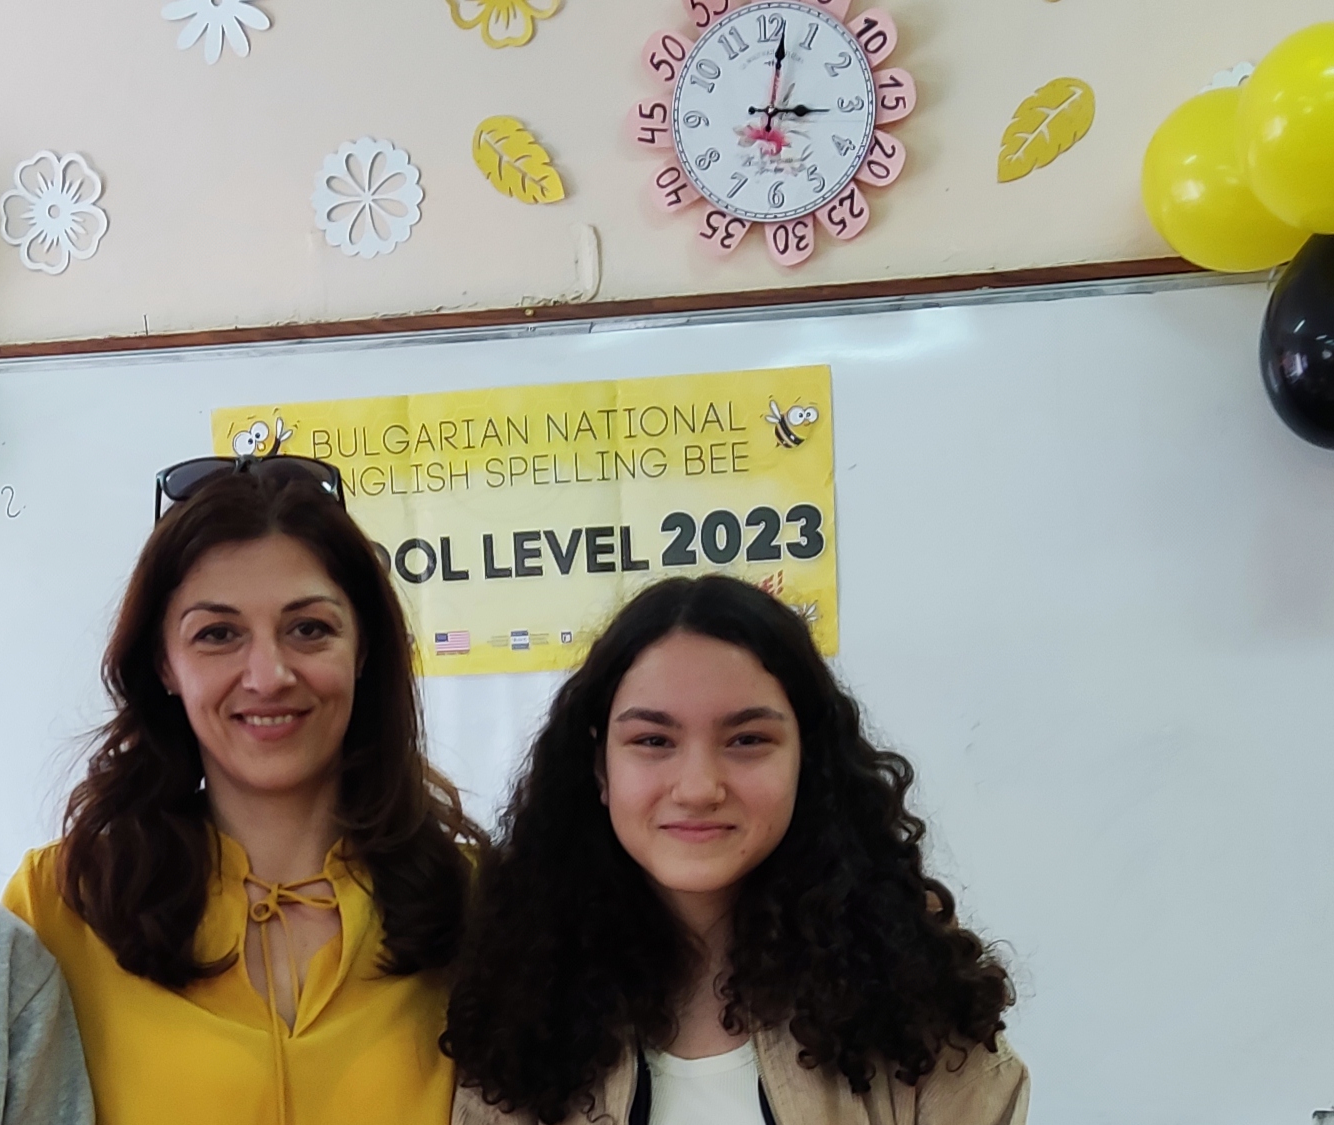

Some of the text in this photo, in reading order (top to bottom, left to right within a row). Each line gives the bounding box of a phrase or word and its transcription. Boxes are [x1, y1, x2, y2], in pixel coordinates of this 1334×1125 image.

[717, 25, 749, 60] 11
[756, 12, 786, 42] 12
[856, 17, 888, 55] 10
[649, 35, 686, 82] 50
[690, 58, 721, 93] 10
[824, 51, 852, 77] 2
[837, 96, 865, 112] 3
[878, 75, 907, 111] 15
[637, 102, 668, 144] 45
[683, 110, 710, 128] 9
[694, 147, 720, 171] 8
[832, 134, 856, 157] 4
[867, 135, 896, 179] 20
[656, 167, 689, 207] 40
[727, 172, 748, 198] 7
[768, 181, 785, 208] 6
[807, 164, 826, 193] 5
[699, 210, 747, 249] 35
[827, 188, 865, 236] 25
[773, 220, 810, 255] 30
[311, 400, 747, 460] BULGARIAN NATIONAL
[485, 446, 668, 488] SPELLING
[684, 440, 750, 477] BEE
[483, 524, 649, 580] LEVEL
[660, 503, 825, 567] 2023
